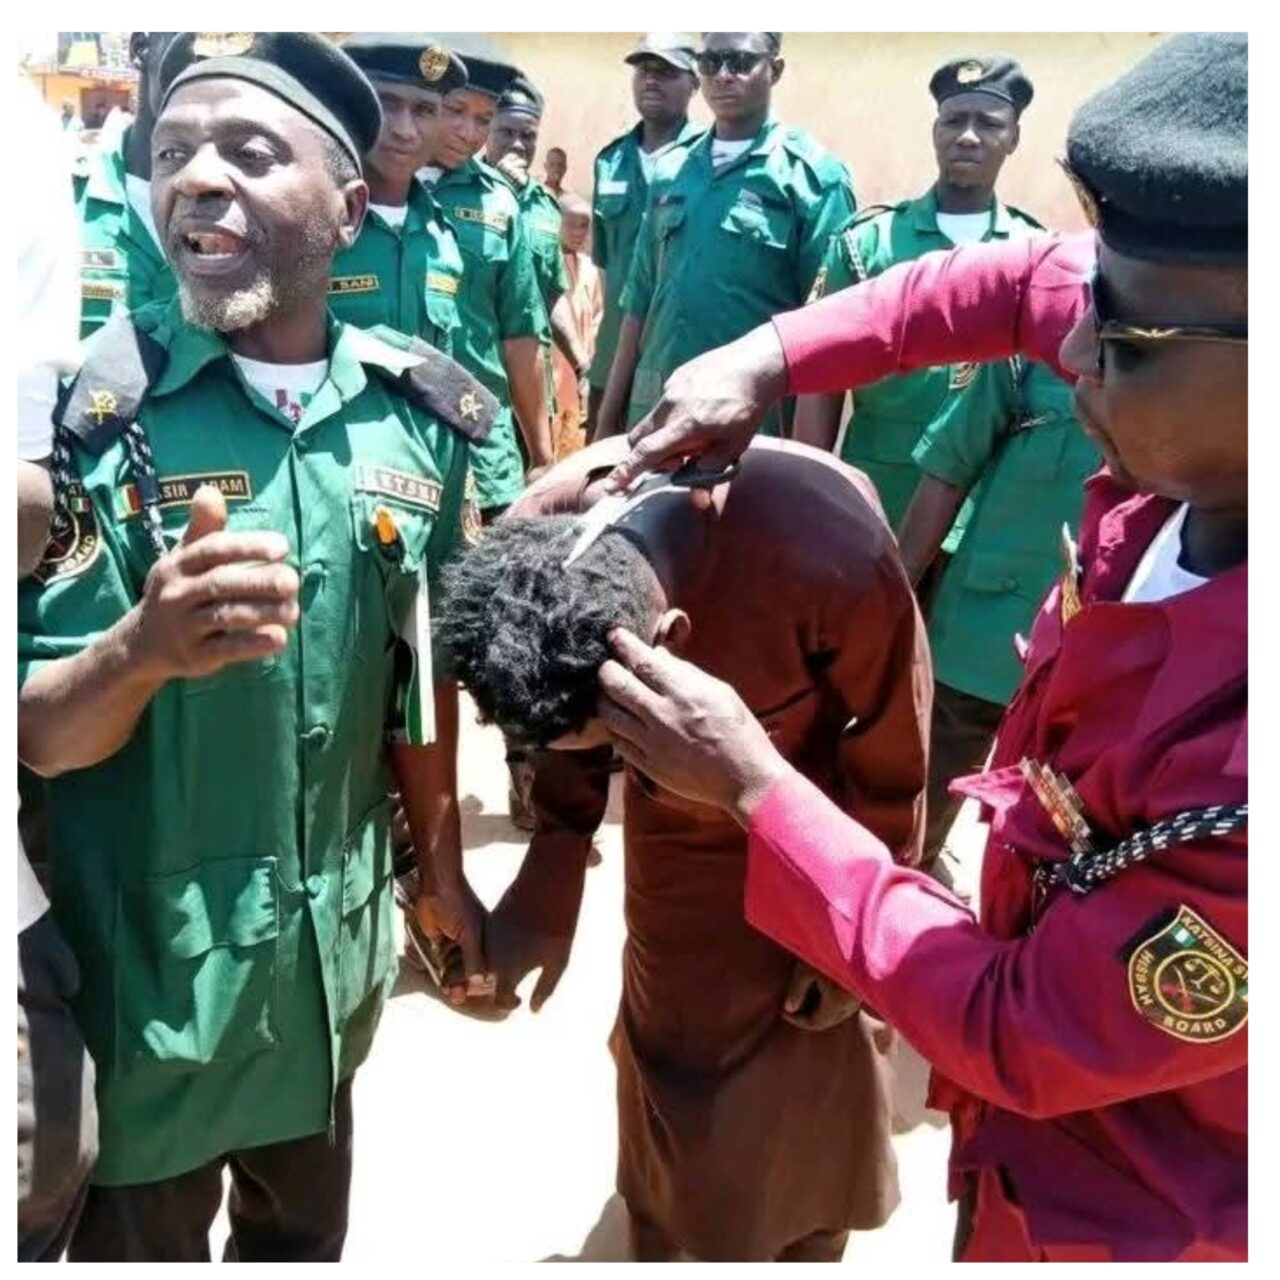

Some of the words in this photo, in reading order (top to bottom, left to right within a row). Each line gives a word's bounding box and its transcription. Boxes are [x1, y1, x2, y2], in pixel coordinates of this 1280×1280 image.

[157, 482, 188, 500] SIR
[1181, 916, 1234, 967] KATSINA
[1162, 1015, 1227, 1034] BOARD
